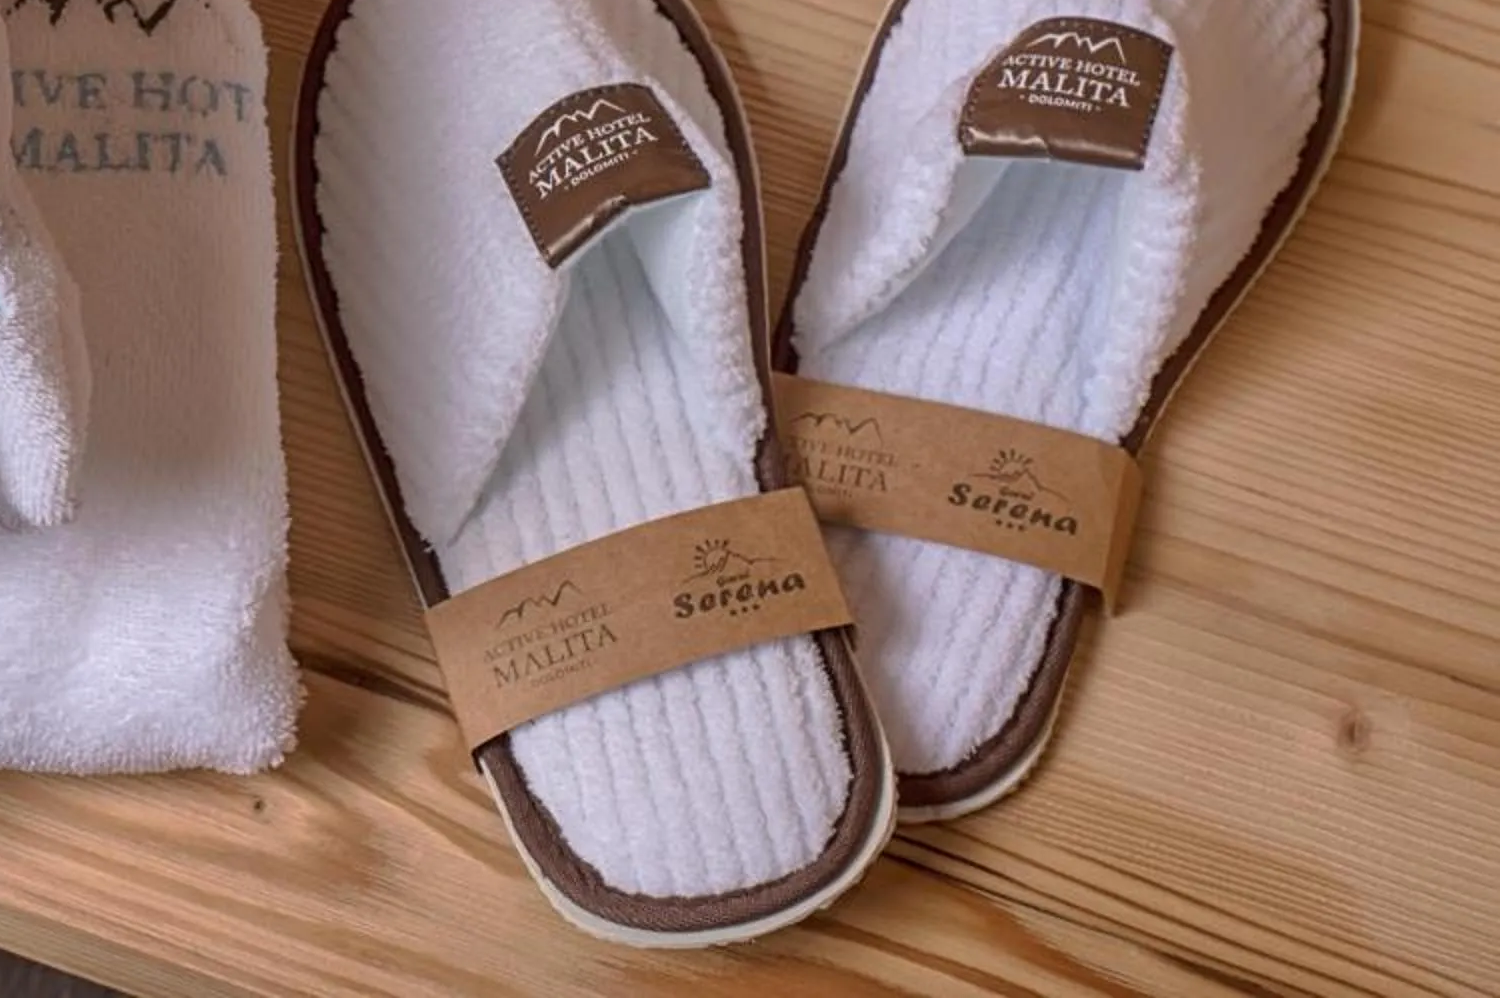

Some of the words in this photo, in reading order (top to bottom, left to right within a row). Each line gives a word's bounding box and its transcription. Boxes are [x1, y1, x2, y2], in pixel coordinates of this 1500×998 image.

[997, 68, 1132, 108] MALITA
[1003, 53, 1073, 71] ACTIVE
[1076, 59, 1141, 86] HOTEL
[132, 70, 250, 122] HOT
[1028, 93, 1092, 112] DOLOMITI
[528, 134, 585, 184] ACTIVE
[586, 112, 652, 141] HOTEL
[535, 126, 659, 199] MALITA
[570, 153, 630, 187] DOLOMITI
[947, 482, 1078, 536] Serena
[673, 572, 806, 619] Serena
[484, 628, 544, 662] ACTIVE
[550, 603, 614, 635] HOTEL
[493, 624, 618, 688] MALITA
